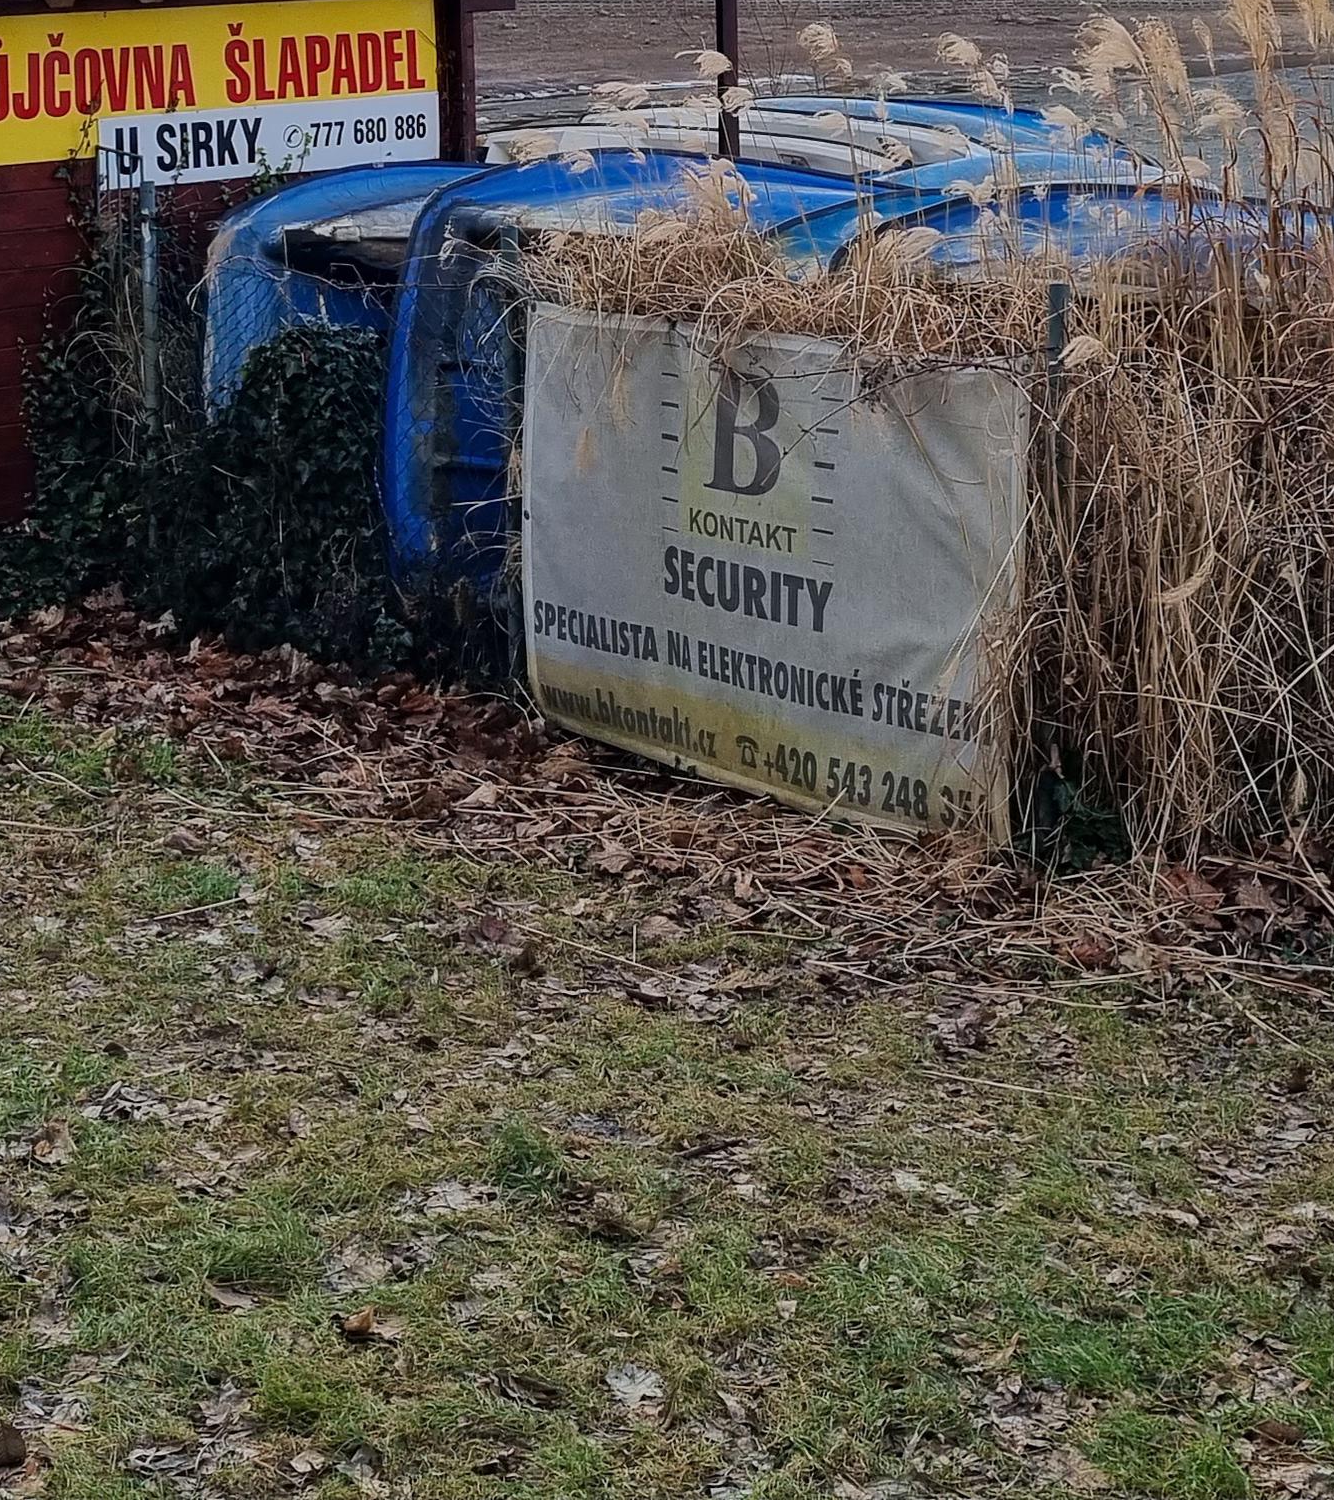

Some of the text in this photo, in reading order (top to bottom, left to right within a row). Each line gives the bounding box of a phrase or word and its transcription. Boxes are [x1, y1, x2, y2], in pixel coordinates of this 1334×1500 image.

[224, 21, 426, 104] ŠLAPADEL
[114, 113, 427, 175] U SIRKY 777 680 886
[703, 364, 783, 497] B
[688, 506, 798, 554] KONTAKT
[663, 544, 833, 634] SECURITY
[533, 599, 660, 664] SPECIALISTA
[666, 629, 693, 673] NA
[698, 641, 865, 718] ELEKTRONICKÉ
[540, 682, 717, 759] www.bkontakt.cz
[763, 742, 818, 791] +420
[826, 756, 873, 807] 543
[881, 770, 929, 821] 248
